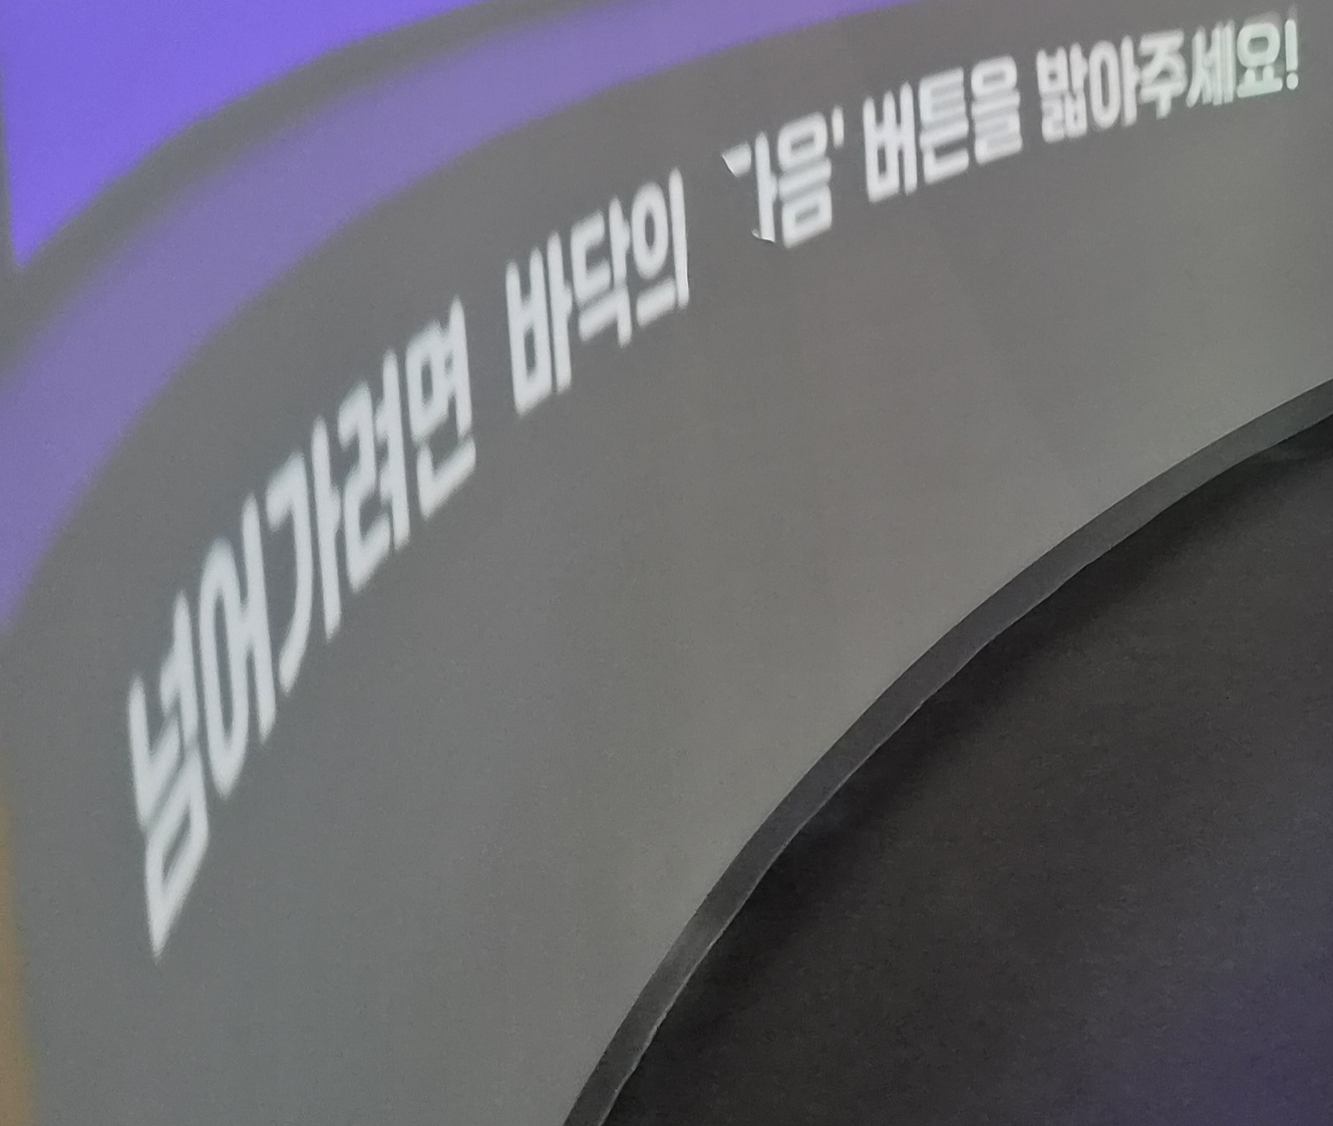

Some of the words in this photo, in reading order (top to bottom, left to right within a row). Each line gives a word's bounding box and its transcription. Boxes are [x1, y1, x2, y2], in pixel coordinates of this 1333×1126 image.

[127, 294, 476, 960] 넘어가려면
[505, 166, 690, 417] 바닥의
[862, 56, 1024, 205] 버튼을
[1035, 8, 1300, 144] 밟아주세요!
